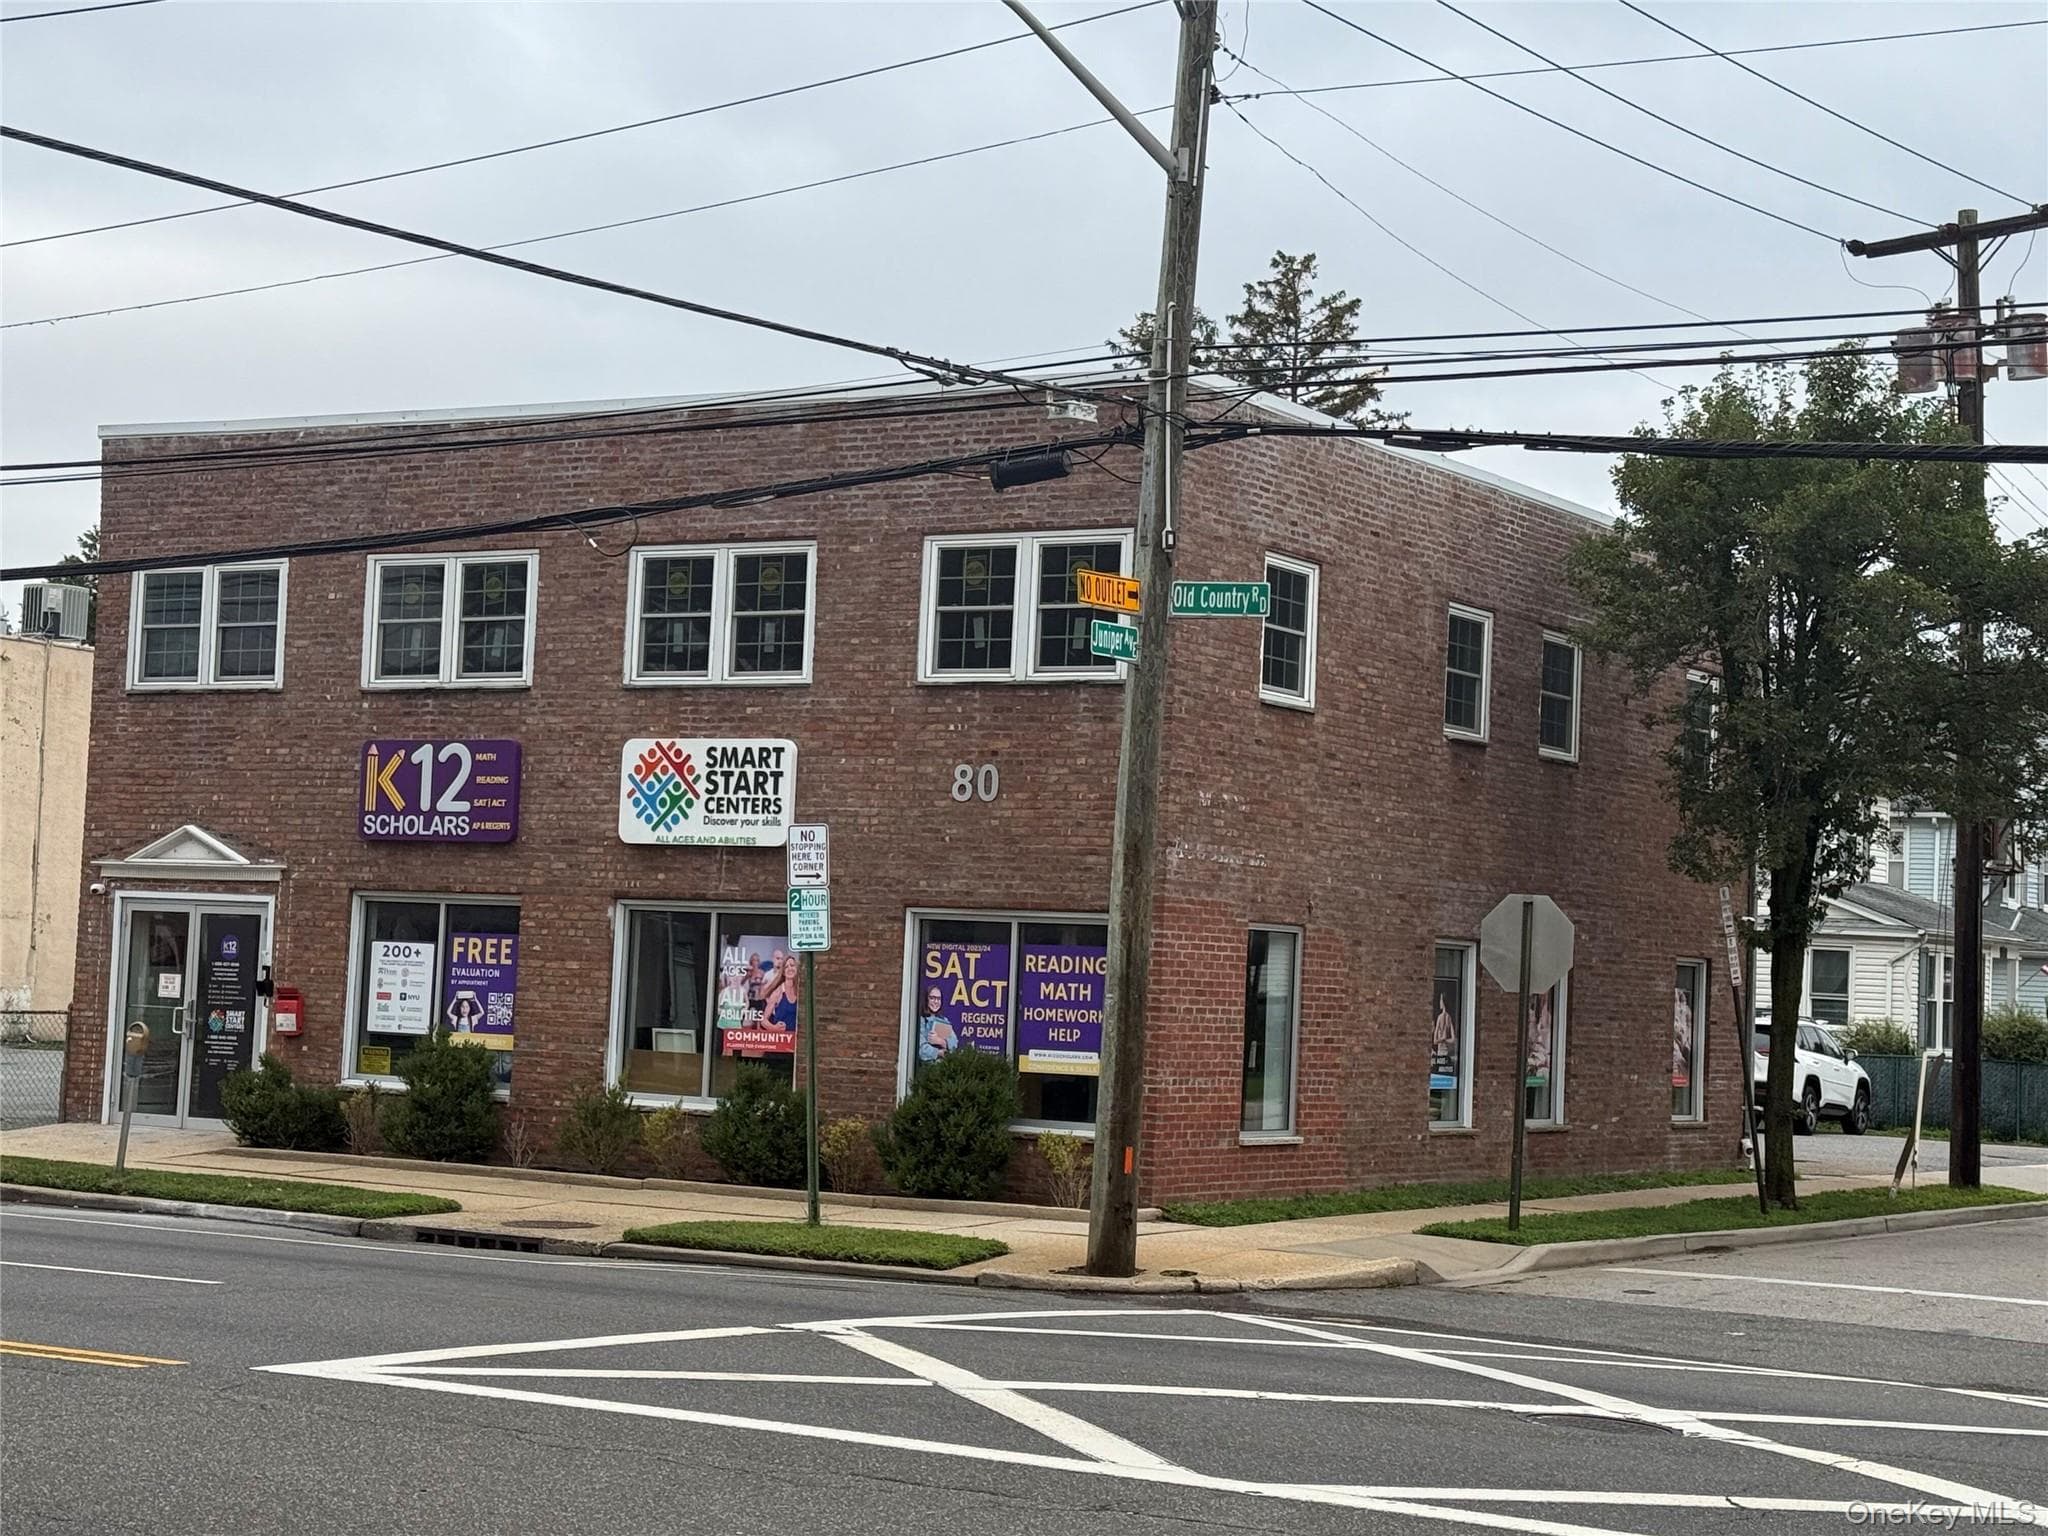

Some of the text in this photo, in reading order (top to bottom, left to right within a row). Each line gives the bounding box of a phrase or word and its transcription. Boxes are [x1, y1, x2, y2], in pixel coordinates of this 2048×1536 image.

[1081, 575, 1127, 606] NO OUTLET
[1174, 585, 1195, 608] Old
[1200, 586, 1250, 613] Country
[1093, 622, 1124, 651] Juniper
[476, 753, 497, 761] MATH
[705, 746, 785, 769] SMART
[365, 743, 472, 812] K12
[476, 776, 509, 784] READING
[704, 770, 784, 796] START
[952, 763, 999, 802] 80
[473, 799, 487, 807] SAT
[491, 799, 507, 808] ACT
[704, 796, 783, 815] CENTERS
[363, 814, 471, 836] SCHOLARS
[472, 822, 481, 830] AP
[485, 822, 511, 830] REGENTS
[703, 815, 782, 829] Discover your skills
[655, 835, 757, 846] ALL AGES AND ABILITIES
[800, 830, 816, 842] NO
[790, 842, 826, 851] STOPPING
[792, 852, 825, 861] HERE TO
[792, 862, 825, 872] CORNER
[791, 892, 827, 908] 2 HOUR
[382, 944, 422, 959] 200+
[452, 936, 514, 966] FREE
[941, 943, 966, 951] DIGITAL
[966, 944, 991, 952] 2023/24
[722, 946, 749, 965] ALL
[721, 965, 748, 977] AGES
[925, 951, 981, 980] SAT
[1025, 954, 1107, 975] READING
[451, 967, 500, 979] EVALUATION
[458, 979, 489, 987] APPOINTMENT
[720, 989, 747, 1007] ALL
[950, 979, 1009, 1008] ACT
[1039, 982, 1092, 1002] MATH
[225, 1016, 245, 1025] START
[719, 1009, 765, 1022] ABILITIES
[960, 1012, 1005, 1025] REGENTS
[727, 1030, 793, 1044] COMMUNITY
[960, 1025, 1004, 1039] AP EXAM
[1048, 1027, 1081, 1043] HELP
